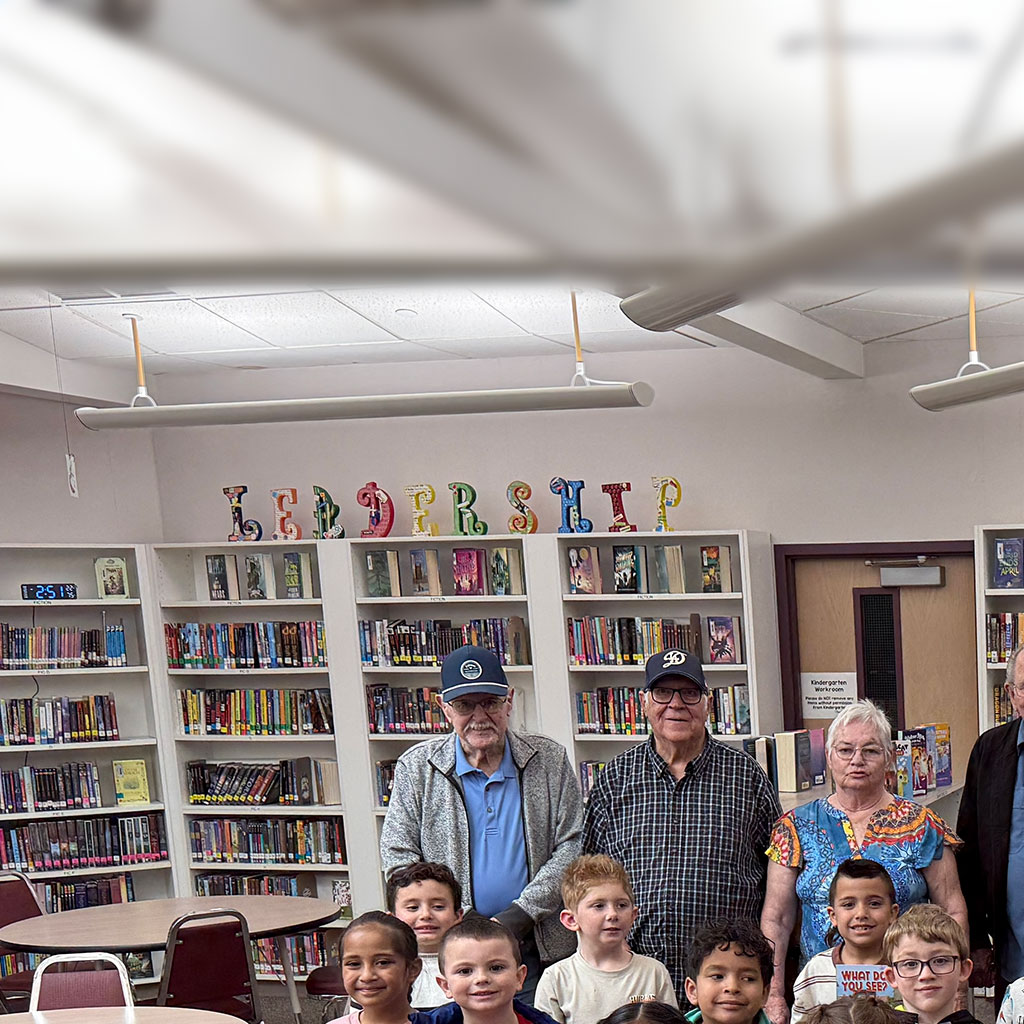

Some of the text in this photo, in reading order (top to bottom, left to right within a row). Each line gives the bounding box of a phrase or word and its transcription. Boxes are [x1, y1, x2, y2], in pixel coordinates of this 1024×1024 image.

[841, 970, 871, 981] WHAT
[841, 981, 888, 992] YOU SEE?
